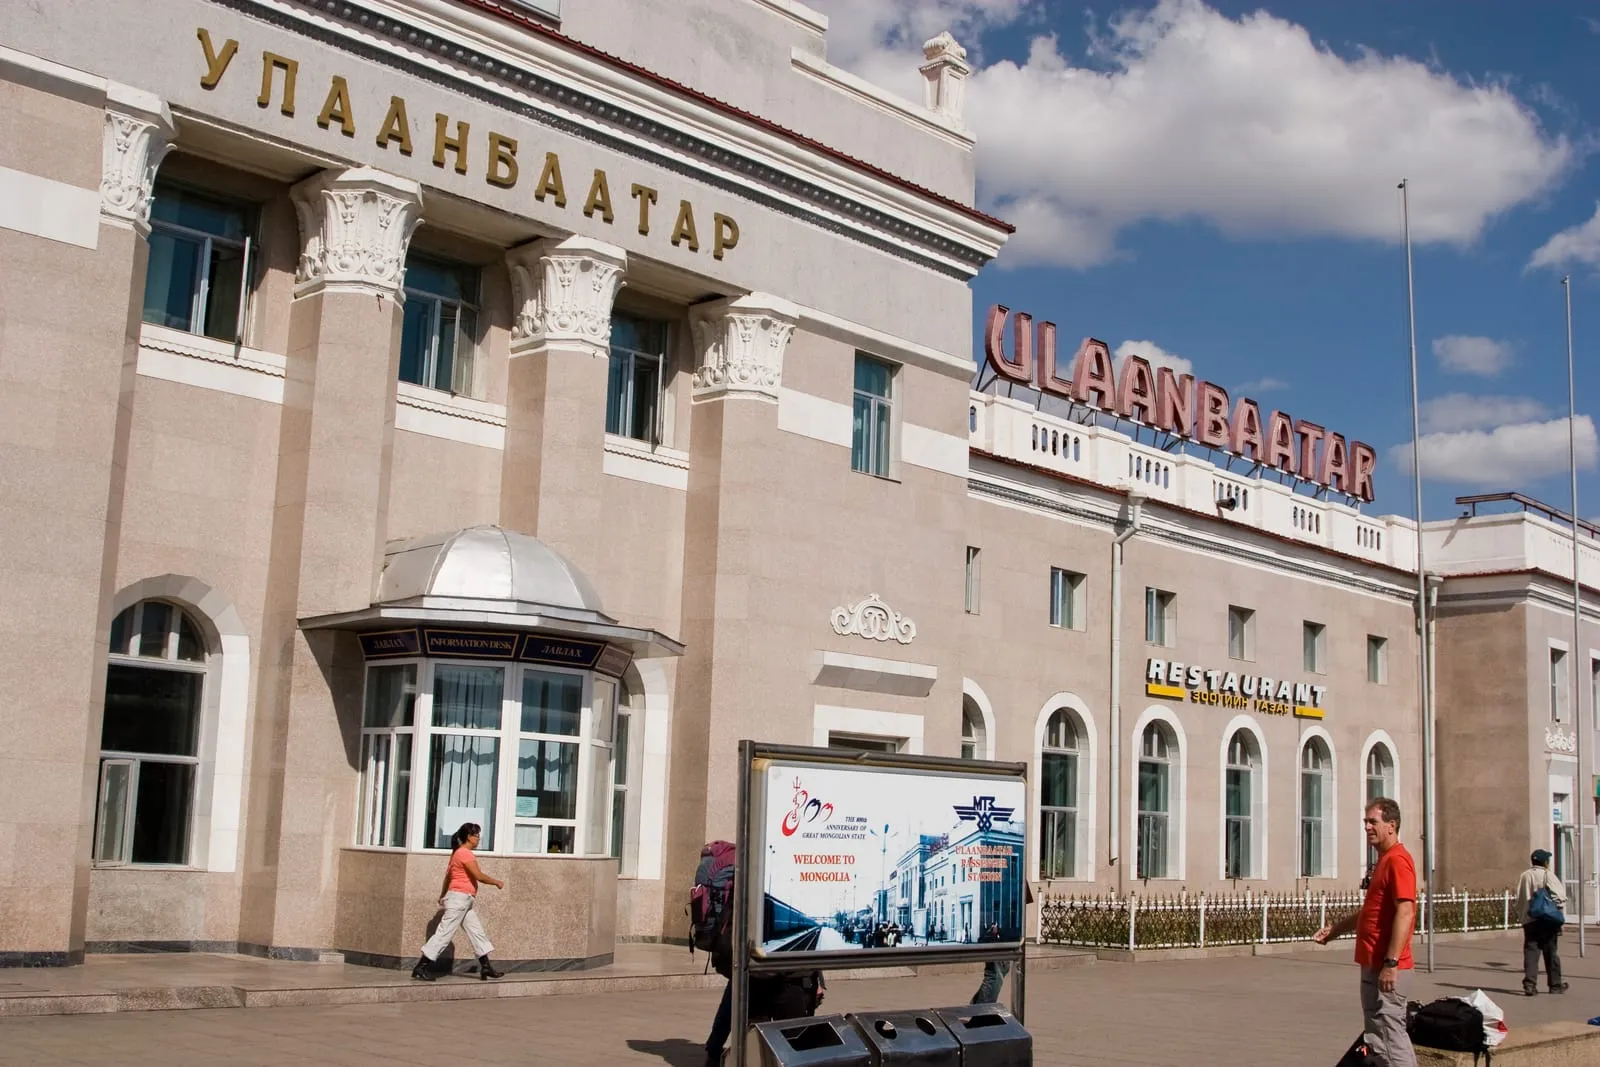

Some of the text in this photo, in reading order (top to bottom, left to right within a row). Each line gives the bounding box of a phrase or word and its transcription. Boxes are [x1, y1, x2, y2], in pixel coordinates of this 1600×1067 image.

[196, 27, 740, 261] УЛААНБААТАР
[985, 303, 1377, 503] ULAANBAATAR
[430, 637, 513, 650] INFORMATION DESK
[1147, 658, 1327, 705] RESTAURANT
[845, 815, 856, 823] THE
[825, 823, 867, 832] ANNIVERSARY OF
[801, 831, 866, 841] GREAT MONGOLIAN STATE
[793, 854, 855, 865] WELCOME TO
[799, 871, 850, 882] MONGOLIA
